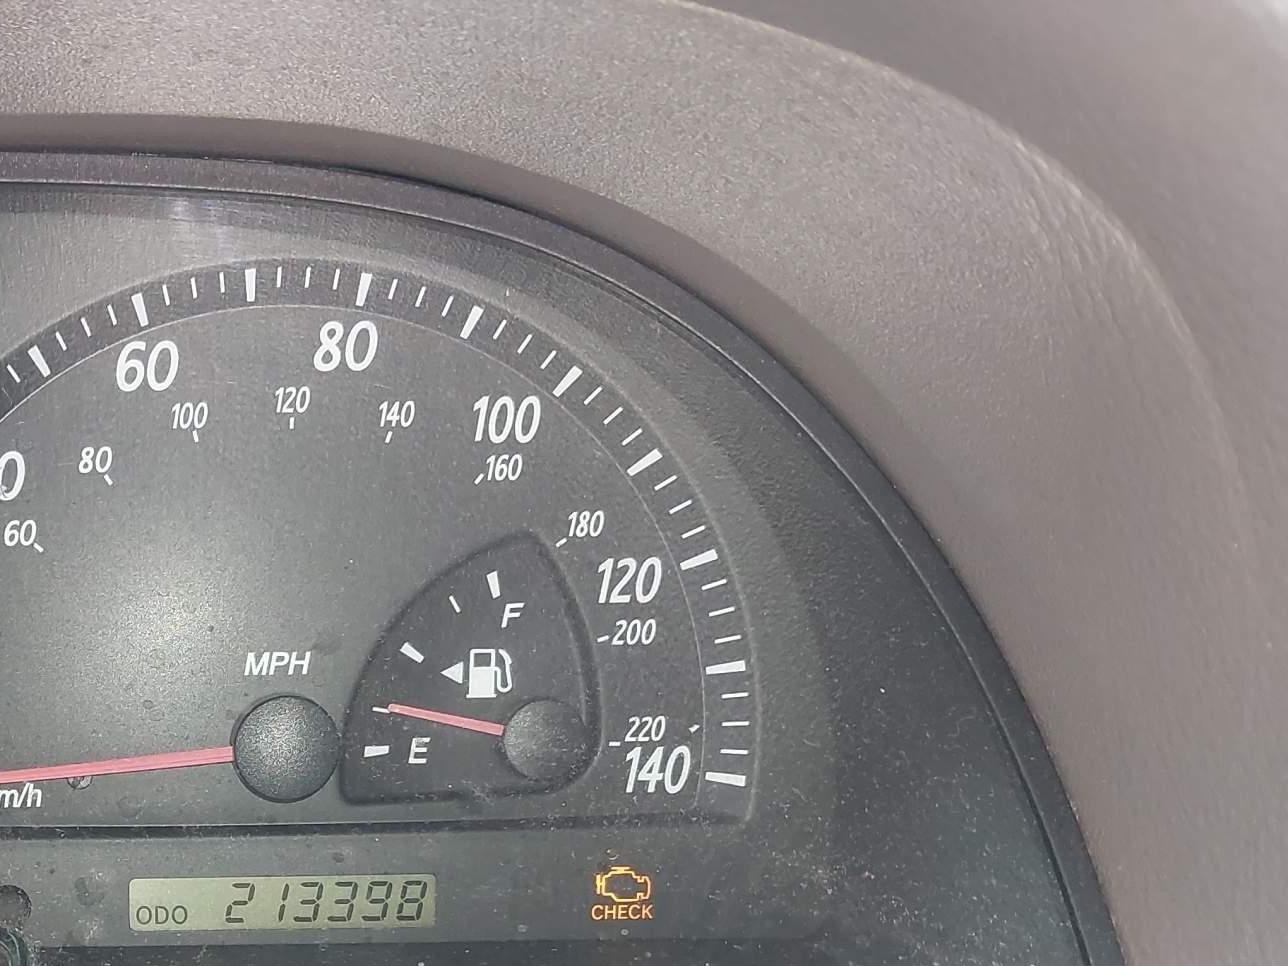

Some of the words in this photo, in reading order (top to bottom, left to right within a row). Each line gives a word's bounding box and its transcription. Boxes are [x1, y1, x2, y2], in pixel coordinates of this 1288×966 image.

[313, 320, 379, 372] 80
[115, 339, 179, 392] 60
[274, 385, 311, 414] 120
[171, 401, 209, 430] 100
[378, 400, 416, 428] 140
[472, 395, 541, 444] 100
[78, 445, 113, 474] 80
[486, 453, 523, 481] 160
[3, 519, 37, 547] 60
[568, 510, 605, 538] 180
[597, 556, 662, 604] 120
[501, 602, 525, 629] F
[611, 618, 657, 646] 200
[243, 651, 312, 676] MPH
[624, 715, 666, 742] 220
[407, 737, 431, 764] E
[624, 745, 691, 794] 140
[135, 905, 188, 925] ODO
[224, 880, 428, 924] 213398
[591, 899, 653, 921] CHECK
